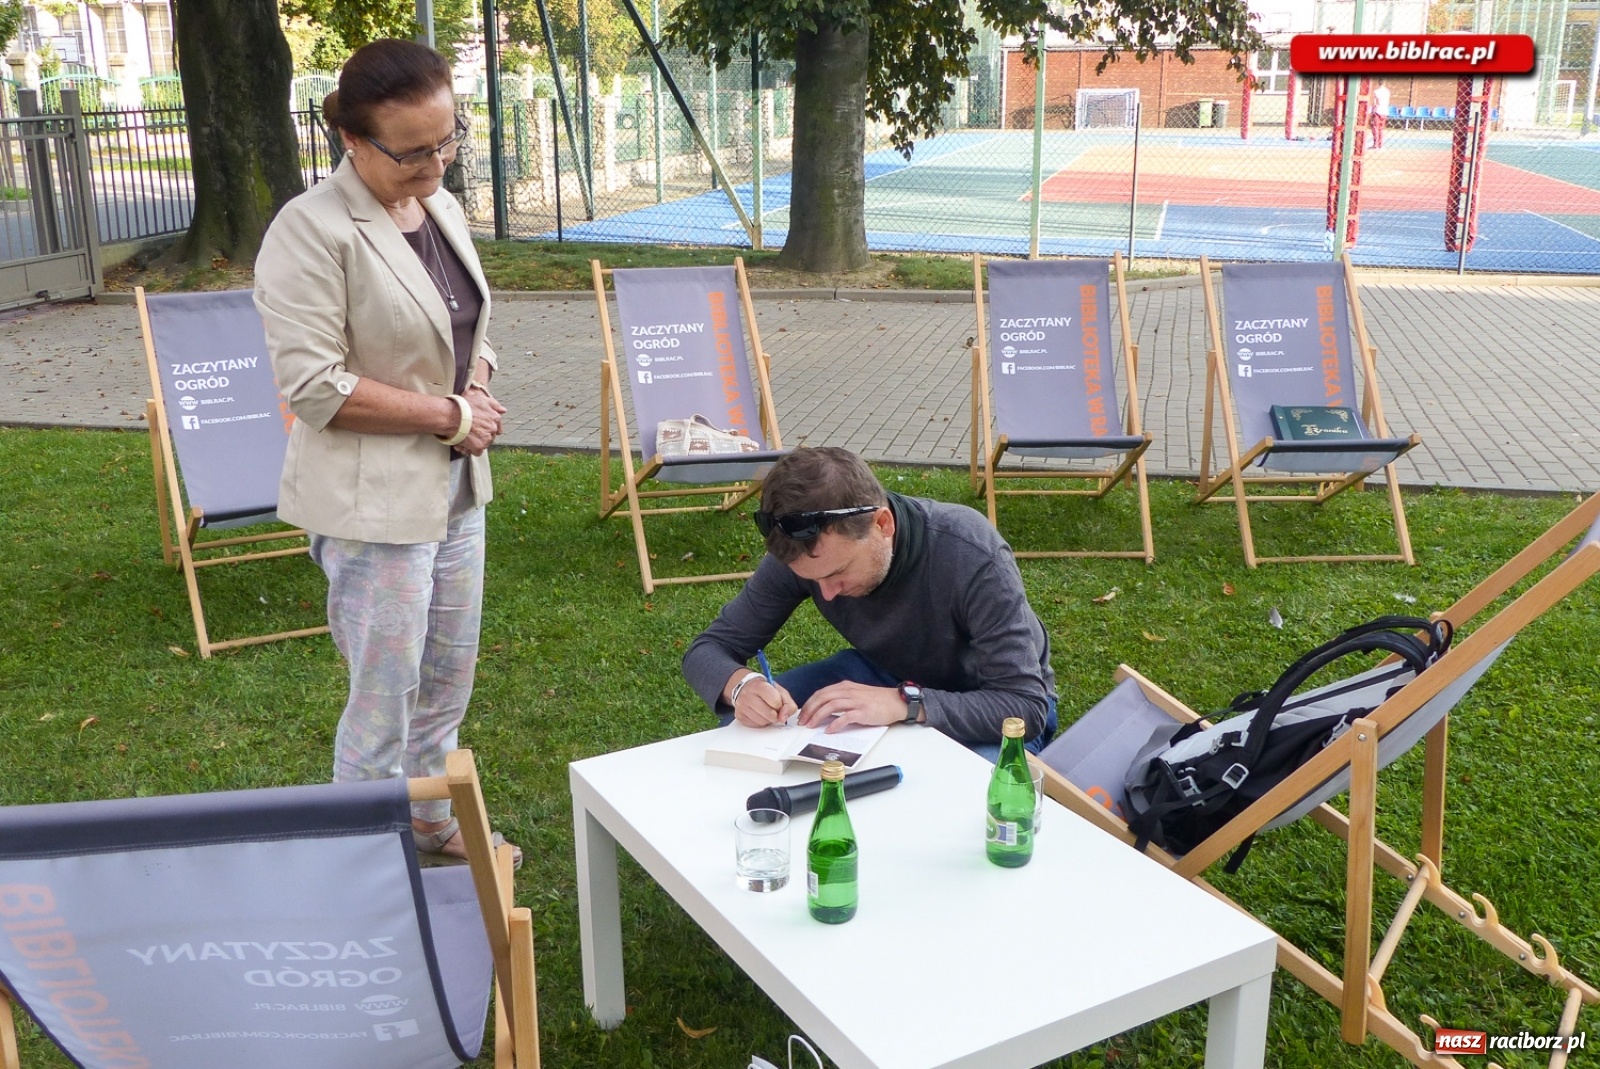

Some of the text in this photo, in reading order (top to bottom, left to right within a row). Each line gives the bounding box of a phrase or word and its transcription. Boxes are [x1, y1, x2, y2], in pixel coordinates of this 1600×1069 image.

[631, 323, 704, 336] ZACZYTANY
[999, 317, 1072, 329] ZACZYTANY
[1235, 318, 1309, 330] ZACZYTANY
[1000, 330, 1046, 342] OGRÓD
[1080, 284, 1102, 396] BIBLIOTEKA
[1235, 332, 1282, 344] OGRÓD
[1316, 285, 1342, 398] BIBLIOTEKA
[633, 337, 680, 350] OGRÓD
[708, 291, 741, 404] BIBLIOTEKA
[171, 356, 258, 375] ZACZYTANY
[174, 375, 230, 391] OGRÓD
[201, 397, 235, 405] BIBLRAC.PL
